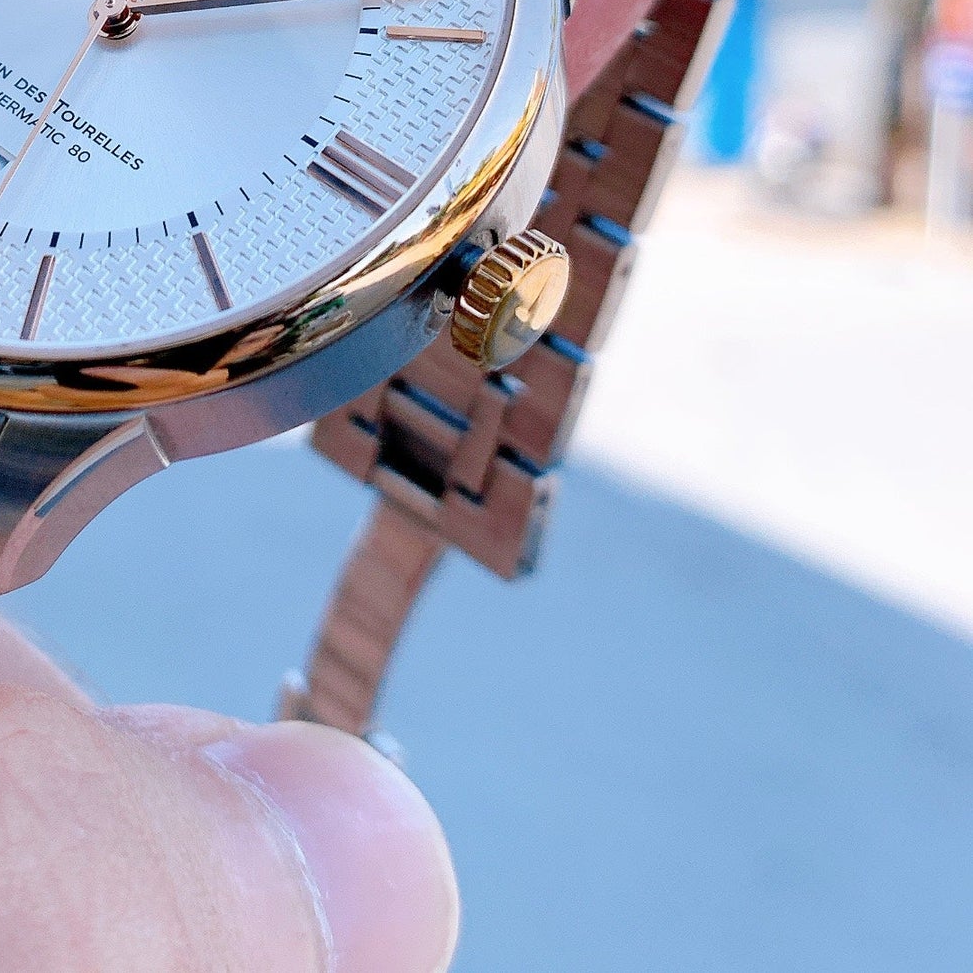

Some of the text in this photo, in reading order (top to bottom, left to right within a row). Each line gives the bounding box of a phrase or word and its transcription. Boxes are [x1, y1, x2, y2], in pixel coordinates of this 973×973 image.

[14, 77, 48, 104] DES
[52, 98, 145, 171] TOURELLES
[68, 144, 92, 164] 80
